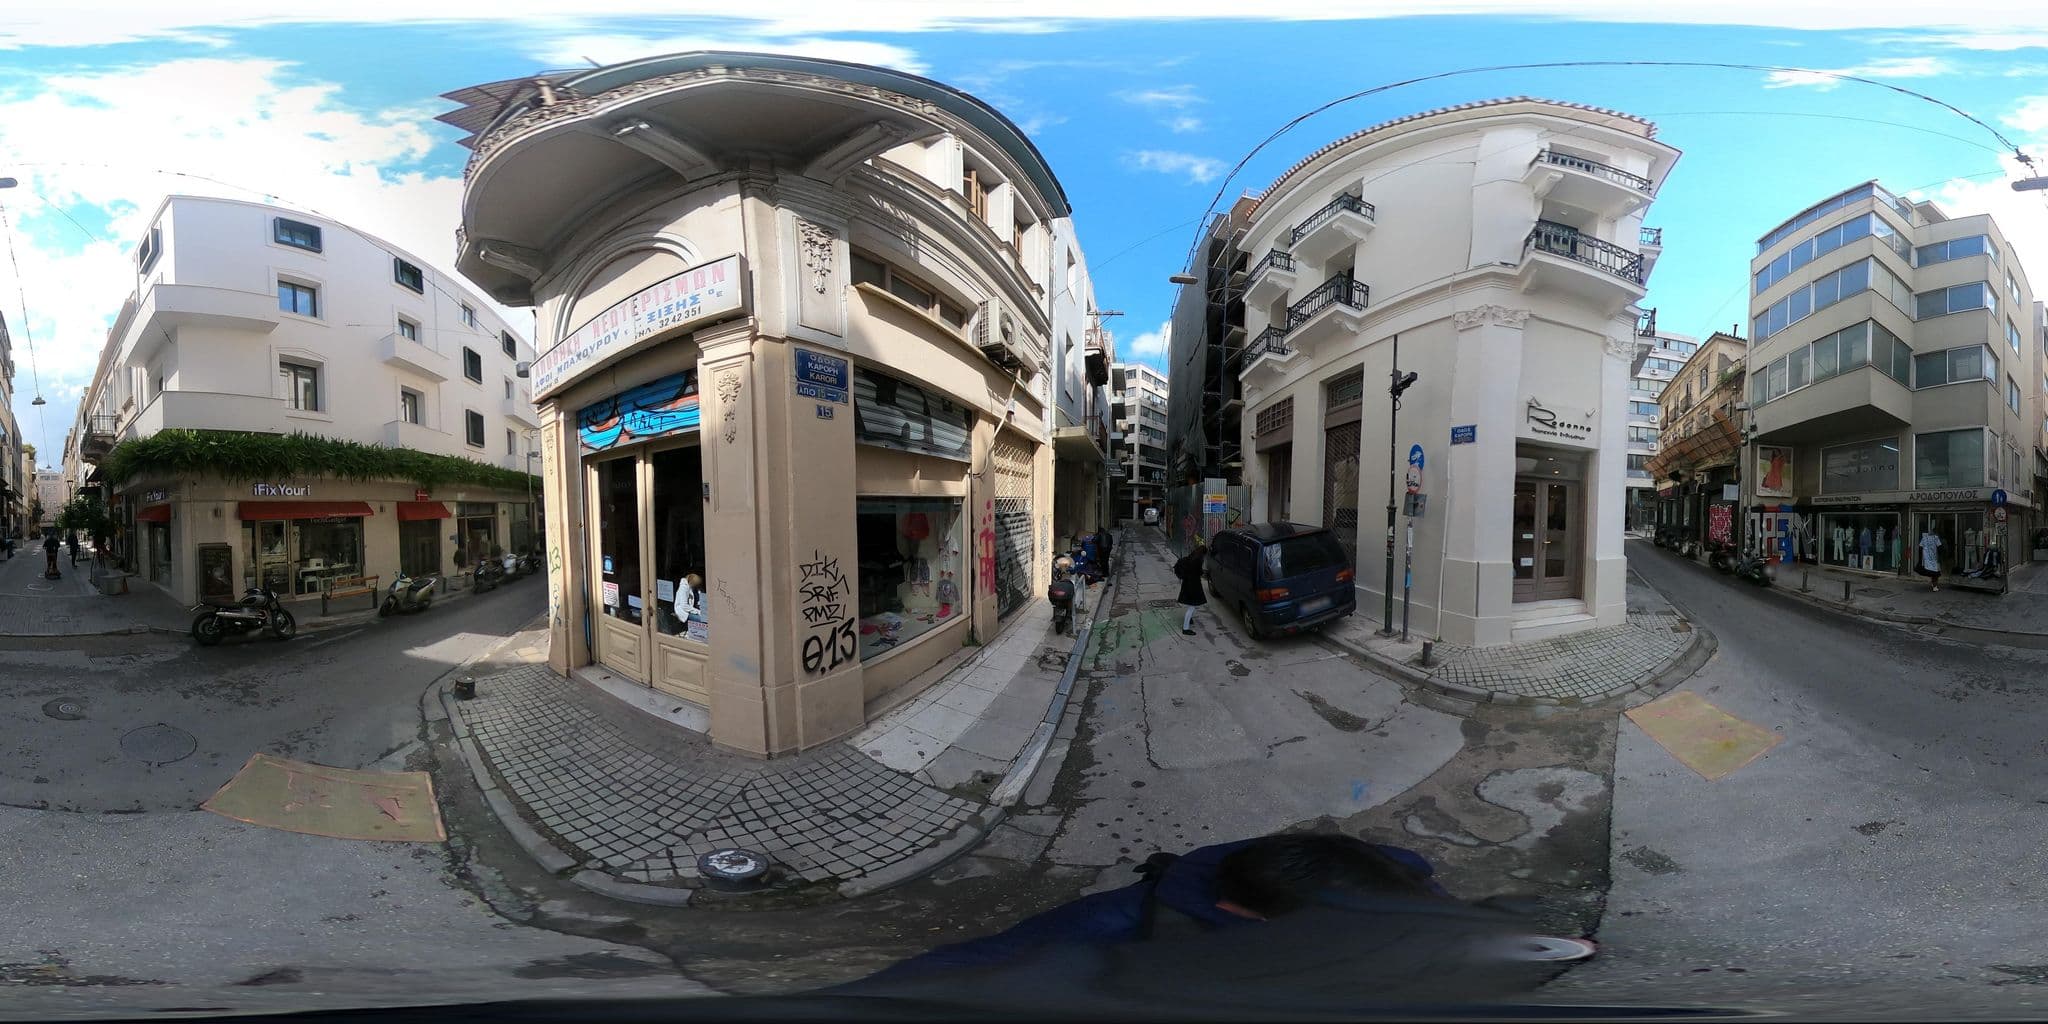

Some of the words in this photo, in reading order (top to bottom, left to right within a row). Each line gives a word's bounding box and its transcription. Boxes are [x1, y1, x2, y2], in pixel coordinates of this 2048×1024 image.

[592, 263, 725, 340] ΝΕΩΤΕΡΙΣΜΩΝ
[659, 318, 670, 328] 32
[672, 313, 682, 323] 42
[685, 305, 701, 319] 351
[809, 354, 837, 367] ΟΔΟΣ
[808, 362, 839, 375] ΚΑΡΟΡΗ
[809, 371, 837, 385] KARORI
[799, 387, 816, 396] ΑΠΟ
[820, 407, 832, 417] 15
